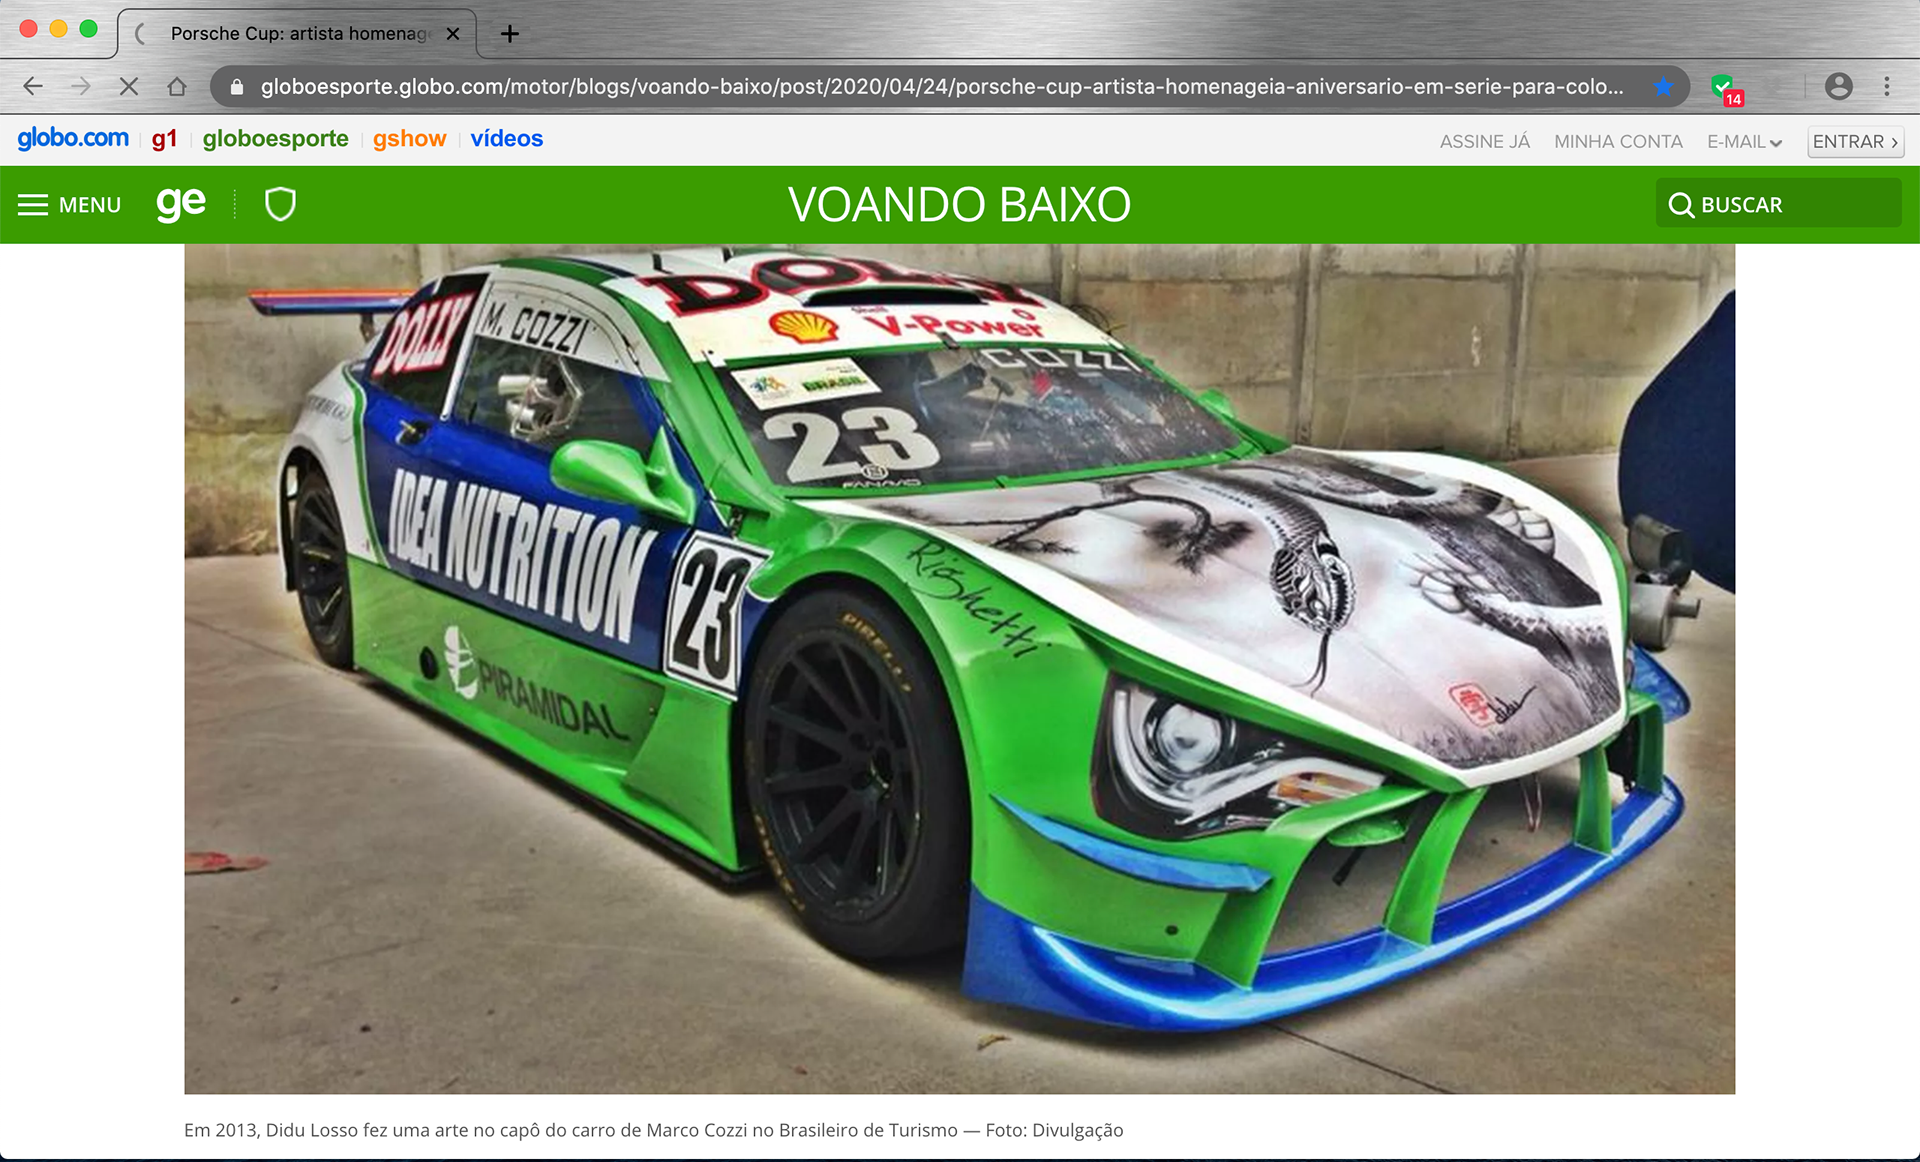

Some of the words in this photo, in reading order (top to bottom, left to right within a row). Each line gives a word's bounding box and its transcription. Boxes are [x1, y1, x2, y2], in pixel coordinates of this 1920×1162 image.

[171, 26, 239, 41] Porsche
[245, 26, 284, 43] Cup:
[290, 26, 343, 41] artista
[1726, 93, 1742, 105] 14
[17, 126, 130, 153] globo.com
[151, 128, 177, 153] g1
[202, 128, 350, 153] globoesporte
[373, 128, 448, 152] gshow
[470, 128, 544, 148] vídeos
[1439, 134, 1504, 149] ASSINE
[1508, 130, 1531, 149] JÁ
[1555, 134, 1615, 149] MINHA
[1620, 134, 1684, 149] CONTA
[1707, 134, 1767, 149] E-MAIL
[1812, 134, 1885, 149] ENTRAR
[59, 196, 121, 214] MENU
[156, 188, 207, 225] ge
[787, 185, 986, 223] VOANDO
[1001, 185, 1131, 223] BAIXO
[1702, 196, 1783, 214] BUSCAR
[372, 292, 477, 378] DOLLY
[480, 301, 507, 338] M.
[510, 306, 590, 356] COZZI
[863, 314, 1046, 339] V-Power
[979, 348, 1144, 375] COZZI
[763, 406, 942, 484] 23
[388, 468, 449, 574] IDEA
[445, 480, 660, 645] NUTRITION
[907, 539, 1053, 659] Righetti
[672, 548, 752, 681] 23
[477, 657, 634, 743] PIRAMIDAL
[184, 1122, 211, 1138] Em
[215, 1122, 261, 1140] 2013,
[266, 1122, 305, 1138] Didu
[311, 1122, 359, 1138] Losso
[362, 1121, 388, 1138] fez
[393, 1125, 430, 1138] uma
[434, 1124, 469, 1138] arte
[473, 1125, 495, 1138] no
[500, 1121, 541, 1142] capô
[545, 1122, 567, 1138] do
[571, 1125, 616, 1138] carro
[620, 1122, 642, 1138] de
[647, 1122, 700, 1138] Marco
[704, 1122, 747, 1138] Cozzi
[752, 1125, 774, 1138] no
[779, 1122, 859, 1138] Brasileiro
[863, 1122, 885, 1138] de
[888, 1122, 958, 1138] Turismo
[986, 1122, 1027, 1138] Foto:
[1033, 1122, 1124, 1142] Divulgação
